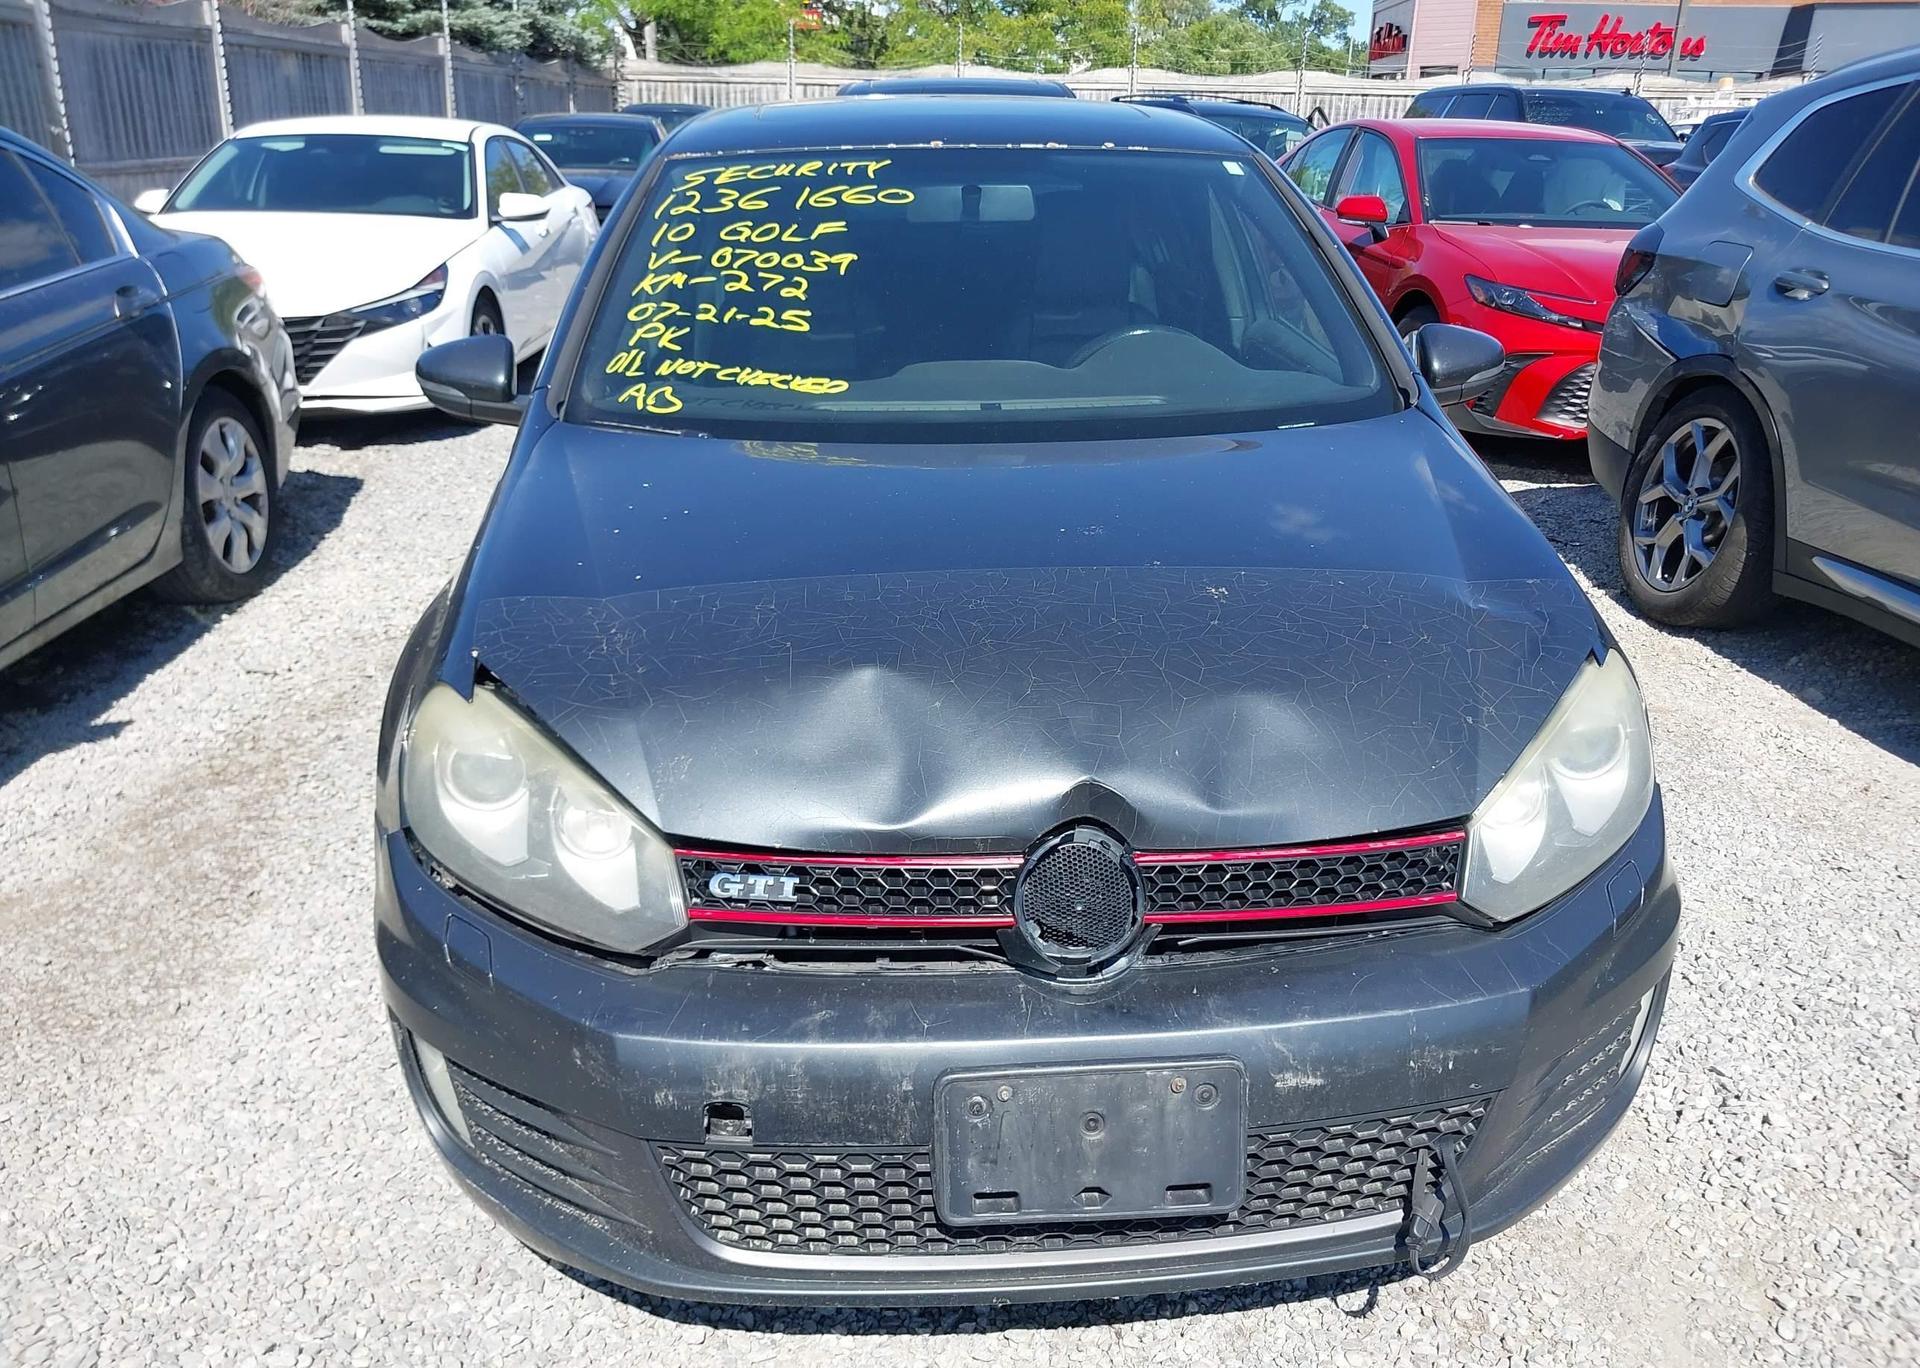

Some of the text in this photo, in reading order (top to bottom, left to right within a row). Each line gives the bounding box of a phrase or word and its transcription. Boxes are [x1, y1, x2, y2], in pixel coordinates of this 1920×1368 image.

[1526, 14, 1582, 57] Tim
[672, 159, 892, 192] SECURITY
[655, 185, 915, 219] 1236 1660
[651, 221, 849, 247] 10 GOLF
[627, 302, 812, 332] 07-21-25
[629, 322, 691, 350] PK
[605, 349, 646, 377] OIL
[655, 358, 721, 379] NOT
[618, 383, 684, 414] AB
[709, 872, 800, 902] GTI
